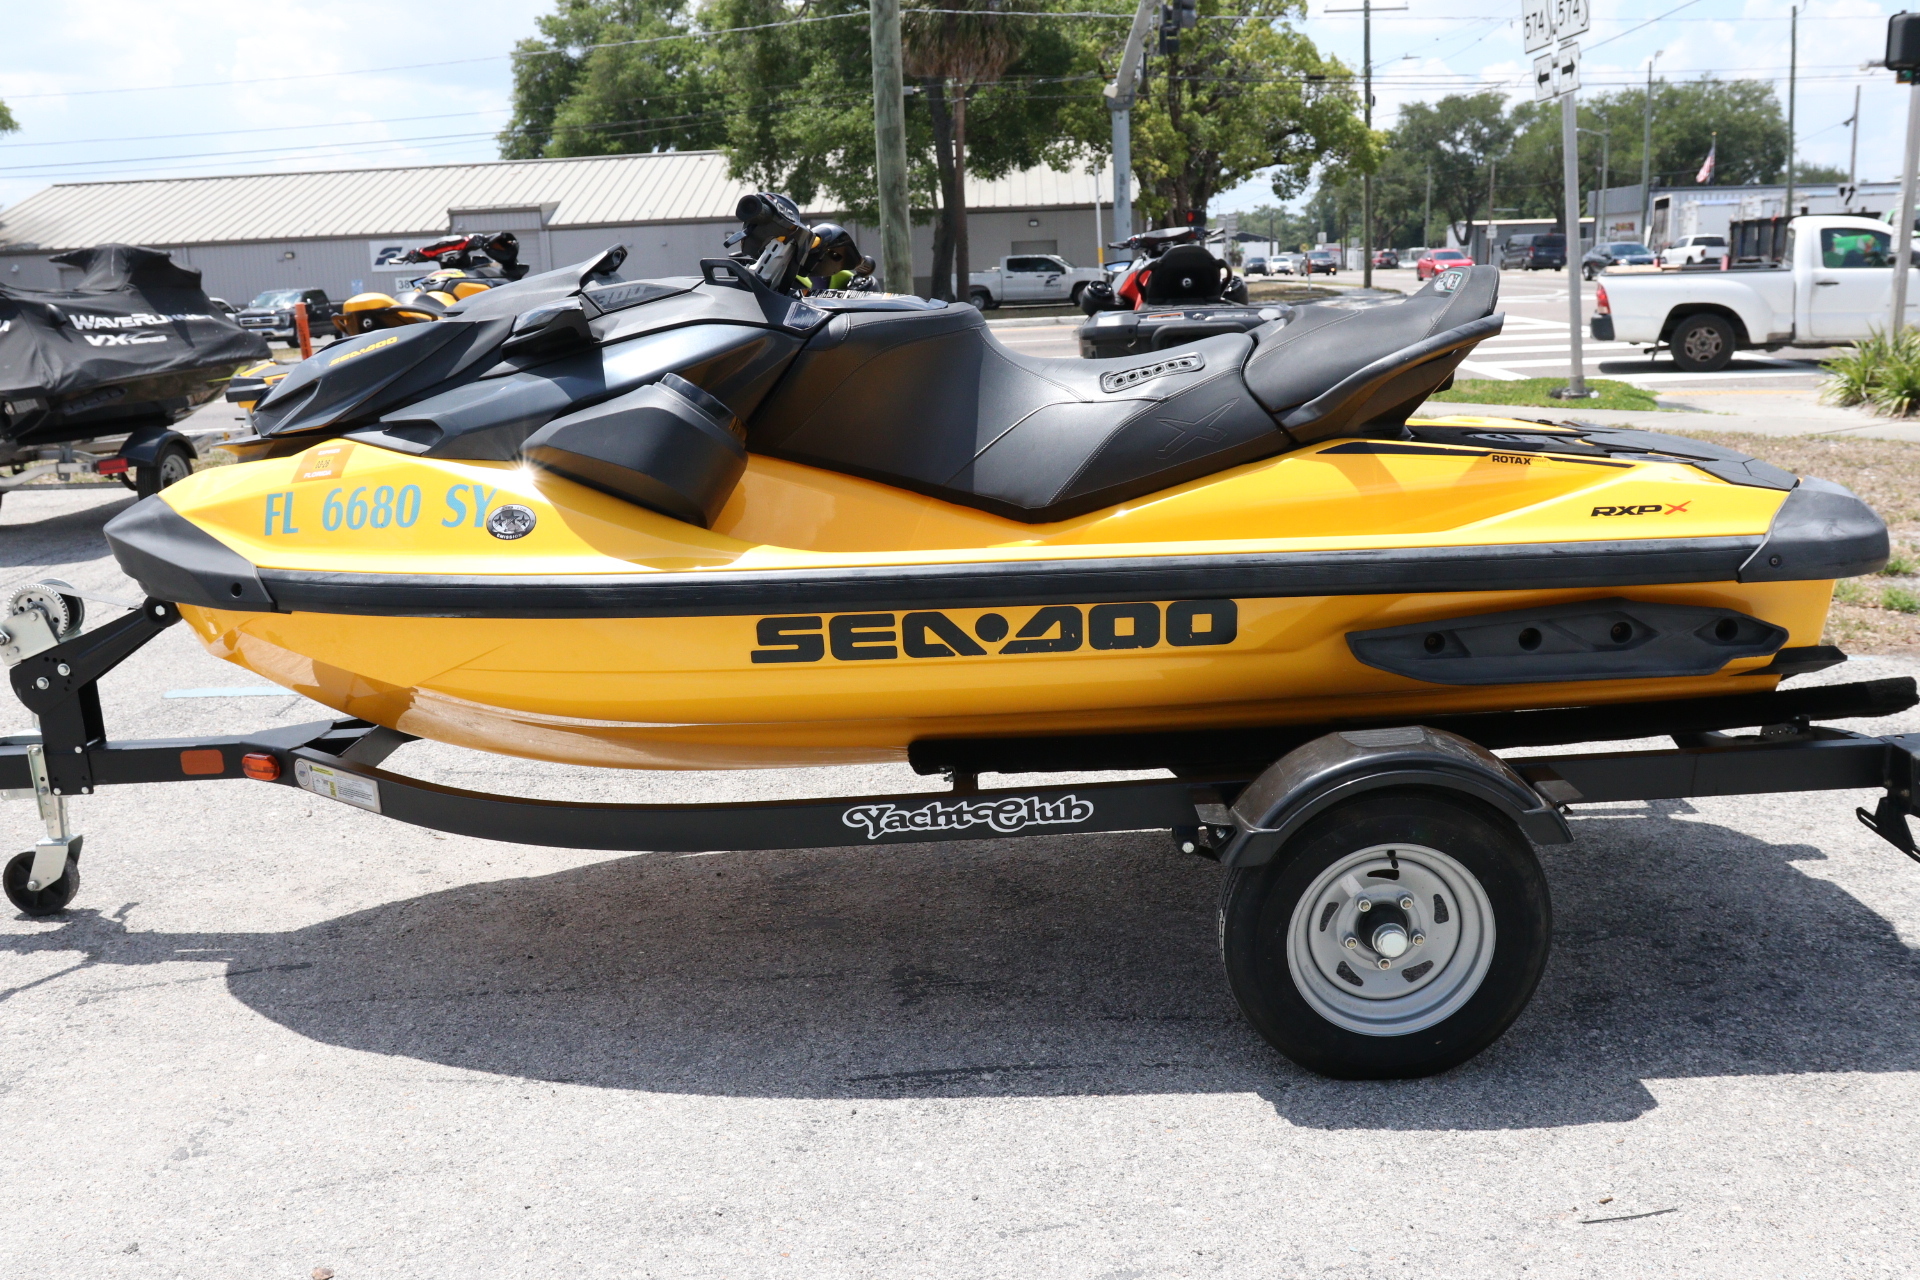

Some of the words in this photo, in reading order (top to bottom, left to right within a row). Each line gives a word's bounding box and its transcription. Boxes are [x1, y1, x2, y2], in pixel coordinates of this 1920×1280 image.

[1559, 0, 1580, 26] 574
[1525, 10, 1545, 39] 574
[69, 313, 213, 330] WAVERU
[1492, 455, 1531, 466] ROTAX
[304, 470, 332, 478] FLORIDA
[264, 491, 299, 536] FL
[322, 484, 422, 531] 6680
[441, 484, 498, 528] SY
